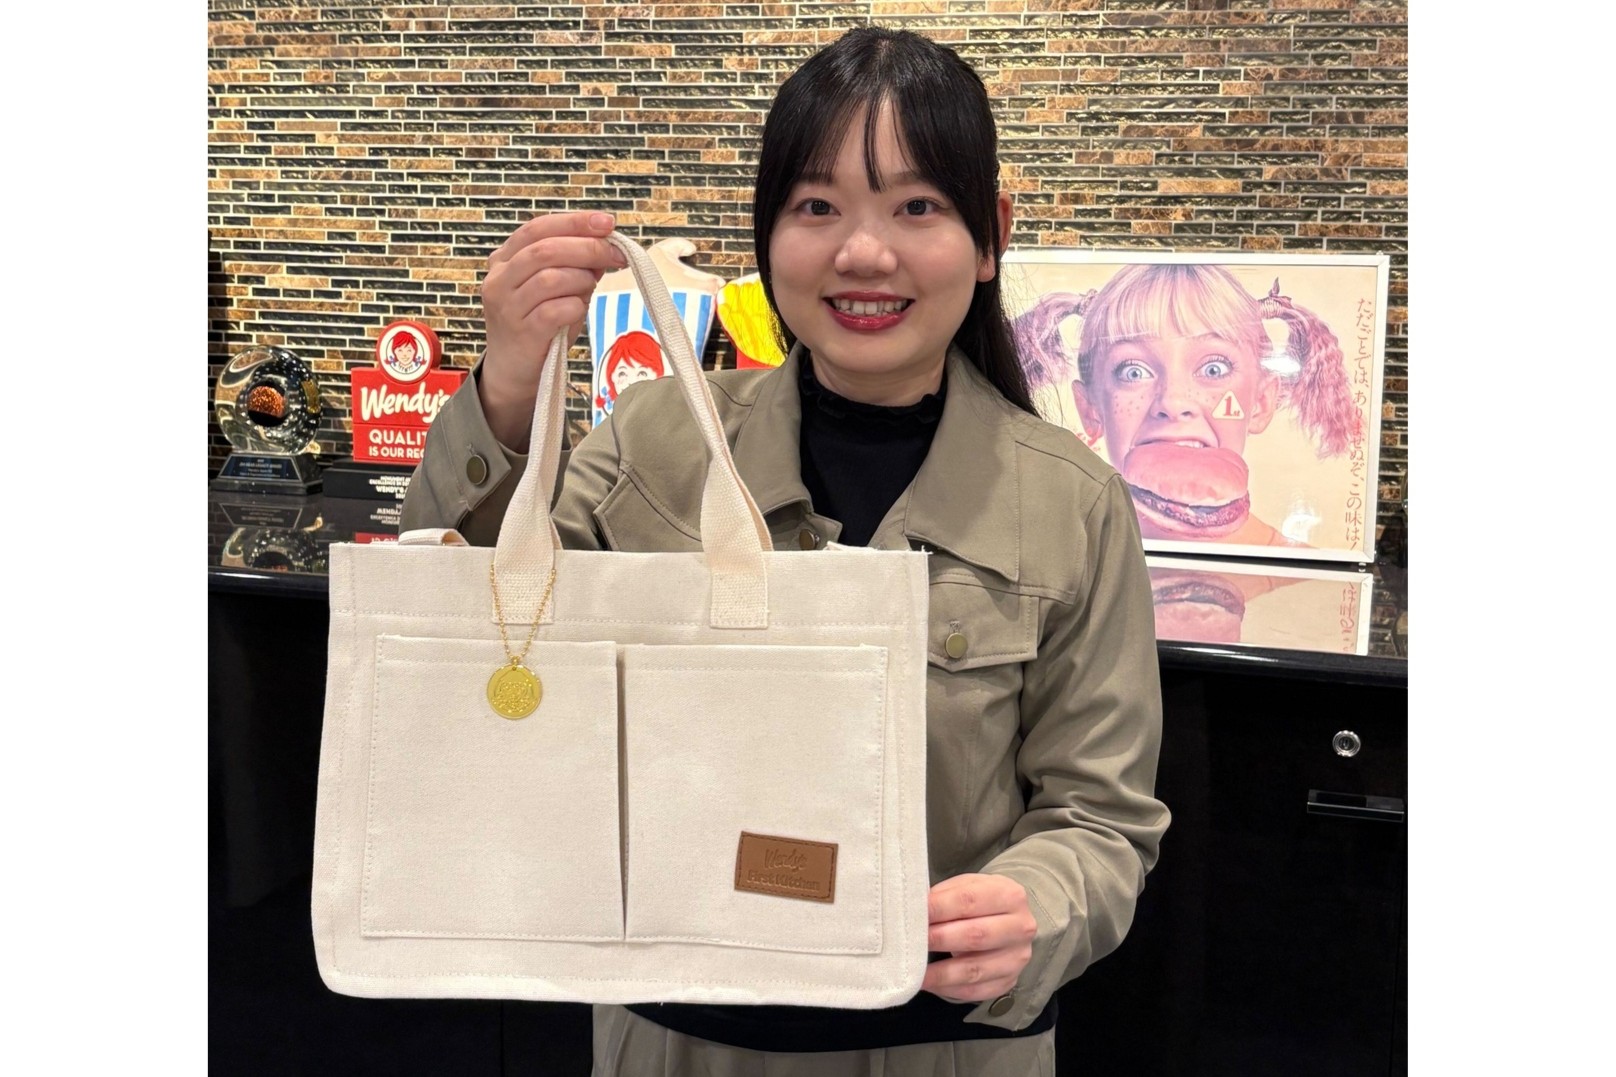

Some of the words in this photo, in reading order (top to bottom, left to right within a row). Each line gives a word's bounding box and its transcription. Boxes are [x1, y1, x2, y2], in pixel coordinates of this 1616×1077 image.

[369, 429, 428, 445] QUALI
[369, 446, 379, 457] IS
[381, 446, 404, 458] OUR
